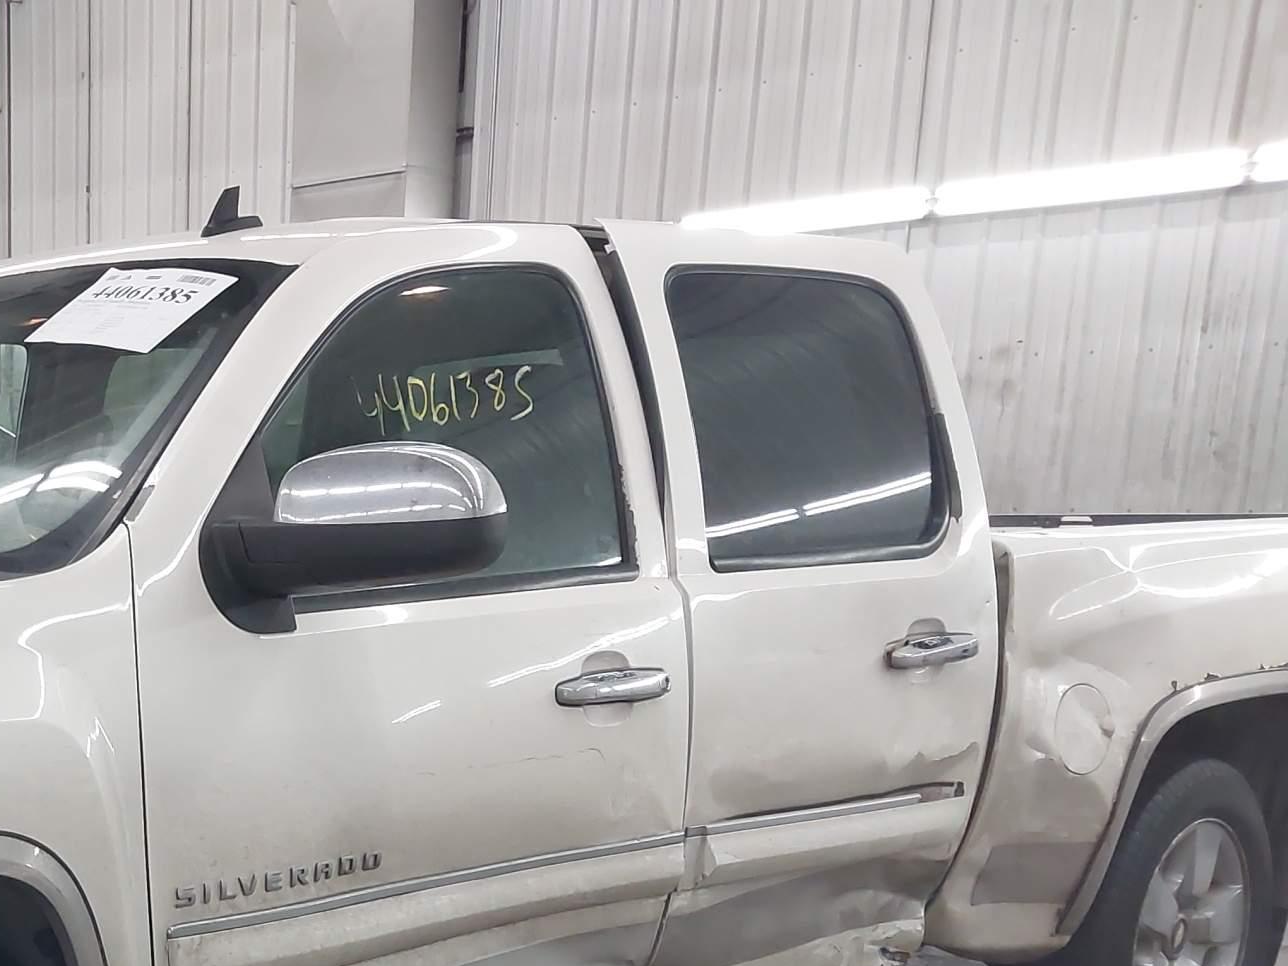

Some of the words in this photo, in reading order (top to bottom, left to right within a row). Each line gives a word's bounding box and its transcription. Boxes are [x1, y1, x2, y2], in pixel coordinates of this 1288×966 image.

[92, 284, 199, 304] 44061385
[350, 365, 534, 437] 44061385
[174, 850, 383, 909] SILVERADO
